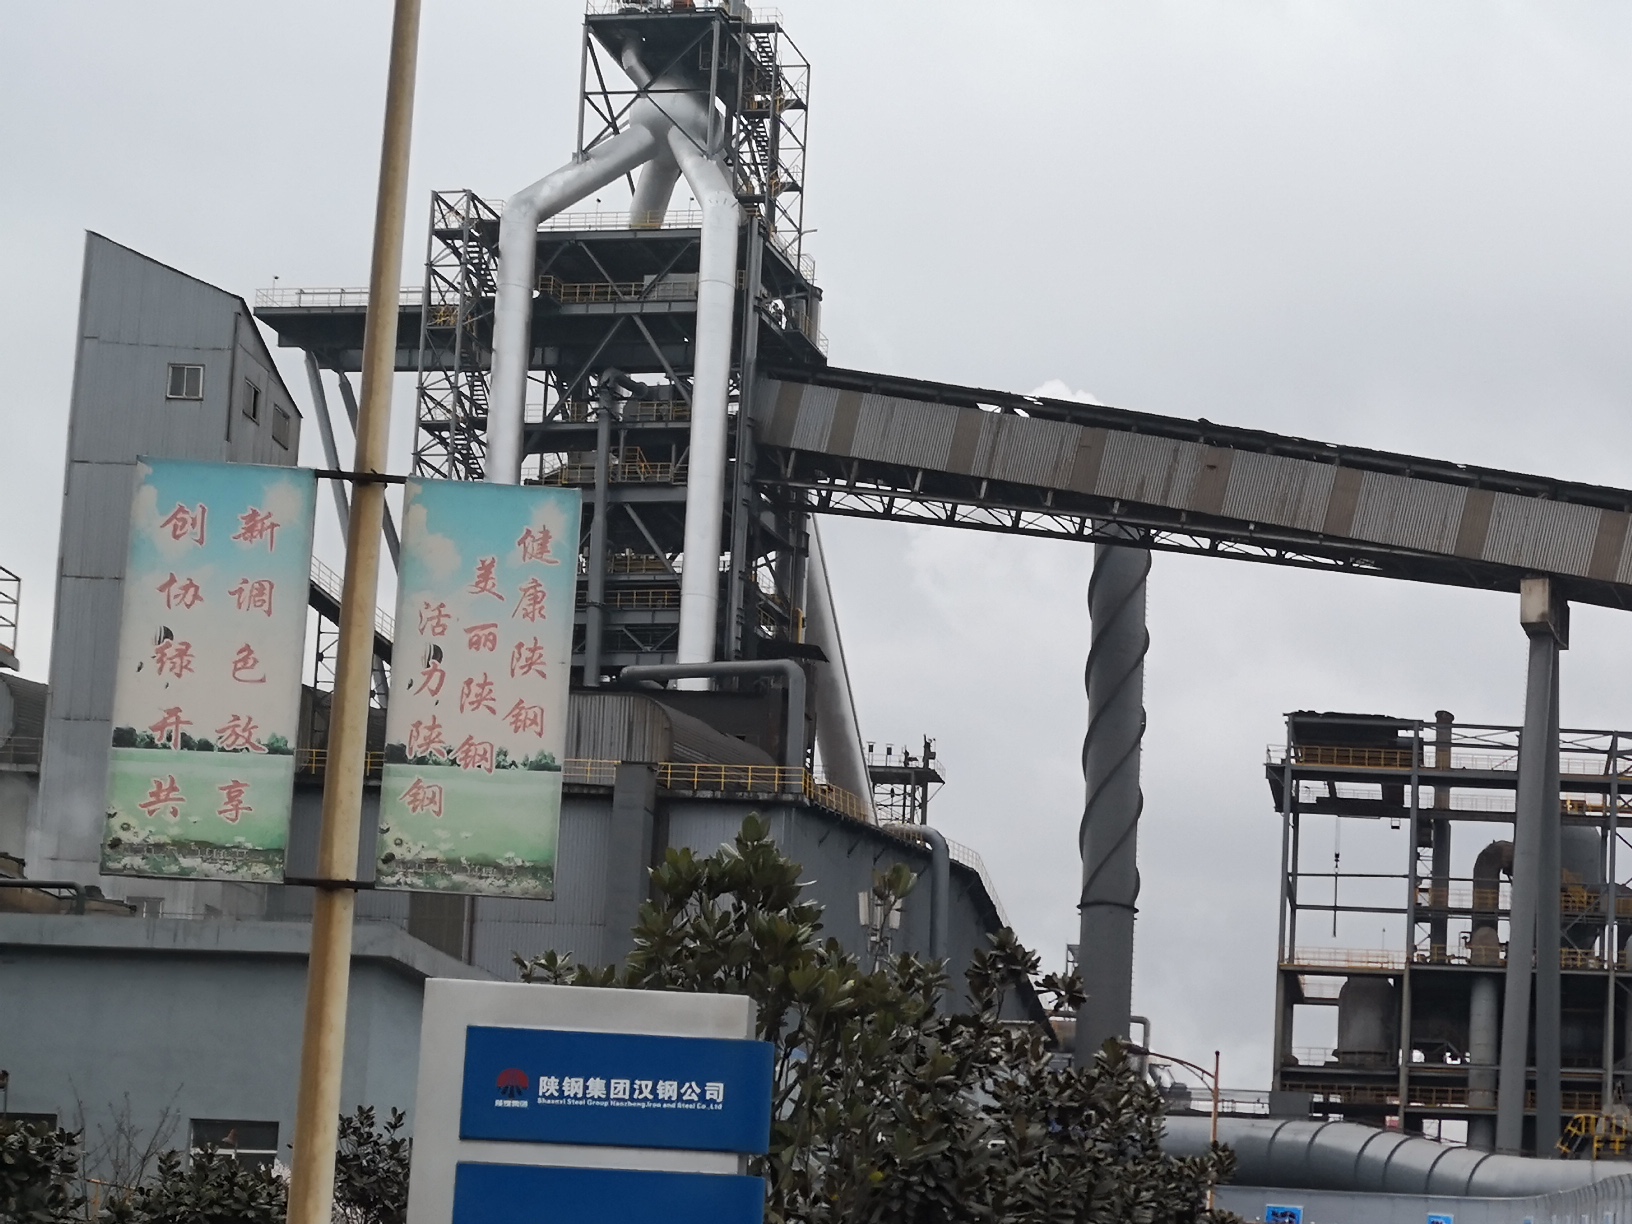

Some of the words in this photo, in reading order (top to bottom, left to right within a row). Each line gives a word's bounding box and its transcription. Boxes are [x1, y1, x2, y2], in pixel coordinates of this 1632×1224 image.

[159, 503, 281, 554] 创新
[157, 572, 276, 618] 协调
[502, 524, 560, 739] 健康陕钢
[152, 642, 267, 684] 绿色
[449, 557, 506, 775] 美丽陕钢
[148, 707, 268, 755] 开放
[399, 601, 453, 819] 活力陕钢
[138, 774, 253, 824] 共享
[538, 1075, 724, 1102] 陕钢集团汉钢公司
[567, 1098, 585, 1106] Steel
[587, 1099, 609, 1107] Group
